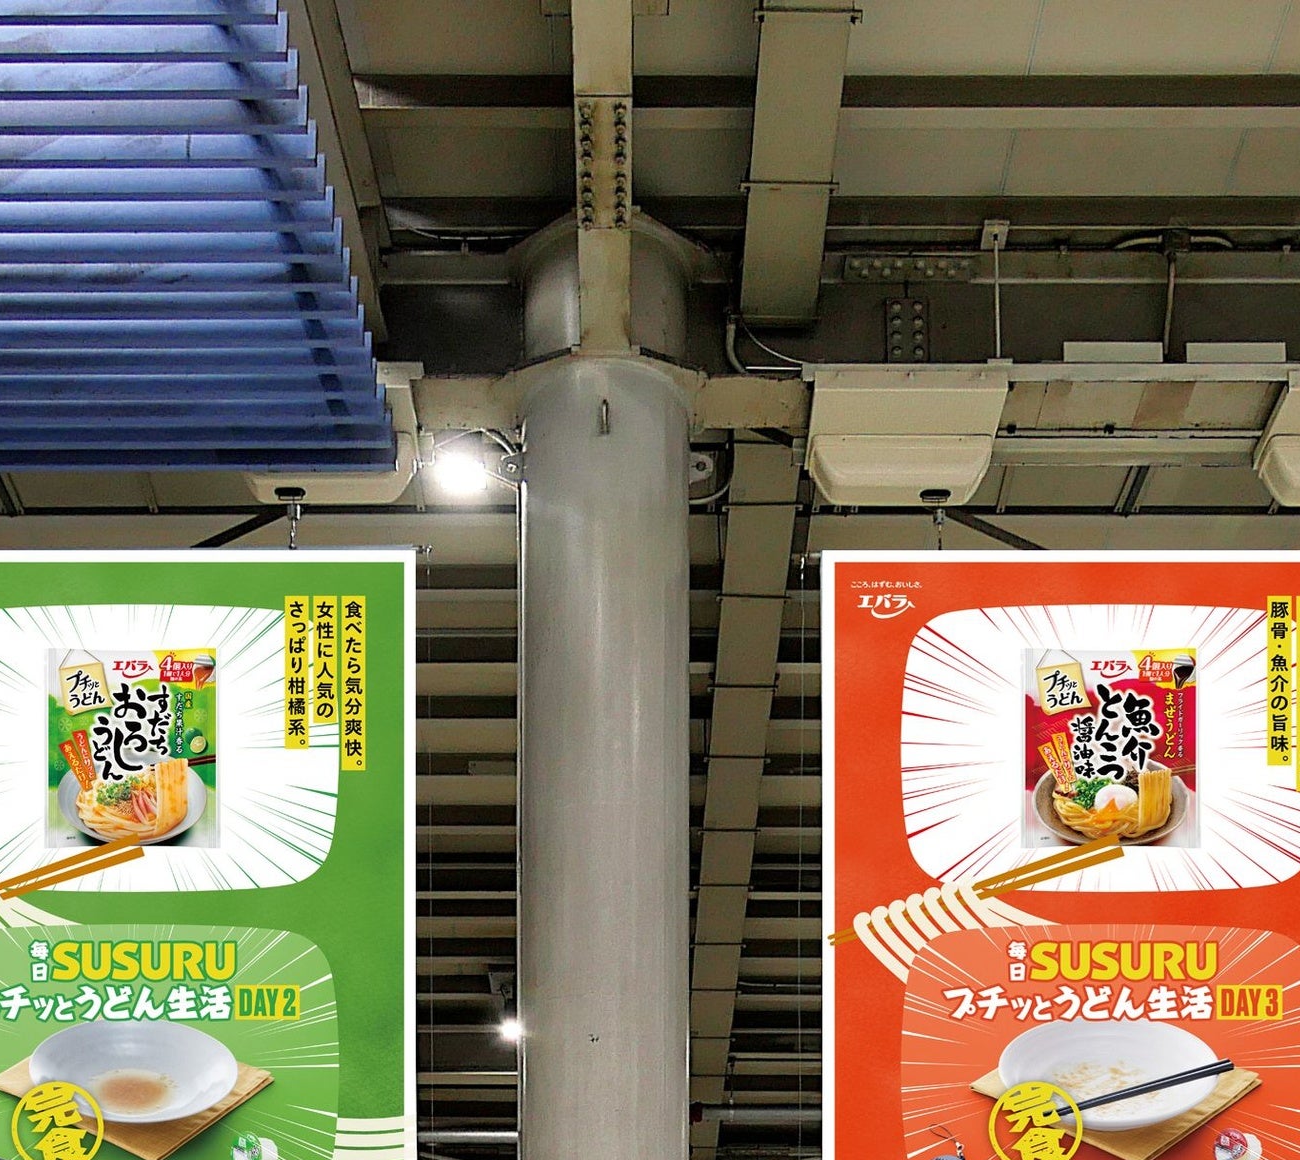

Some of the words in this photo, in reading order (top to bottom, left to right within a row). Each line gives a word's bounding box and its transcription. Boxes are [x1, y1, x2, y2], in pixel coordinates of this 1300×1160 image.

[851, 581, 922, 589] こころ、はずむ、おいしさ。
[857, 595, 916, 619] エバラ
[67, 670, 99, 692] プチッと
[288, 601, 306, 746] さっぱり柑橘系。
[317, 601, 334, 719] 女性に人気の
[345, 601, 362, 767] 食べたら気分爽快。
[1044, 670, 1077, 692] プチッと
[1271, 601, 1289, 764] 豚骨・魚介の旨味。
[70, 692, 105, 708] うどん
[113, 683, 147, 771] おろし
[148, 685, 171, 755] すだち
[1047, 692, 1083, 708] うどん
[1164, 693, 1176, 758] まぜうどん
[93, 716, 123, 780] うどん
[1071, 716, 1095, 778] 醤油味
[1095, 684, 1124, 780] とんこつ
[1122, 693, 1159, 770] 魚介
[30, 941, 49, 983] 毎日
[52, 942, 236, 980] SUSURU
[1008, 941, 1027, 982] 毎日
[1029, 942, 1218, 980] SUSURU
[240, 988, 277, 1017] DAY
[282, 988, 296, 1017] 2
[943, 985, 1212, 1021] プチッとうどん生活
[1221, 988, 1260, 1017] DAY
[1265, 988, 1278, 1017] 3
